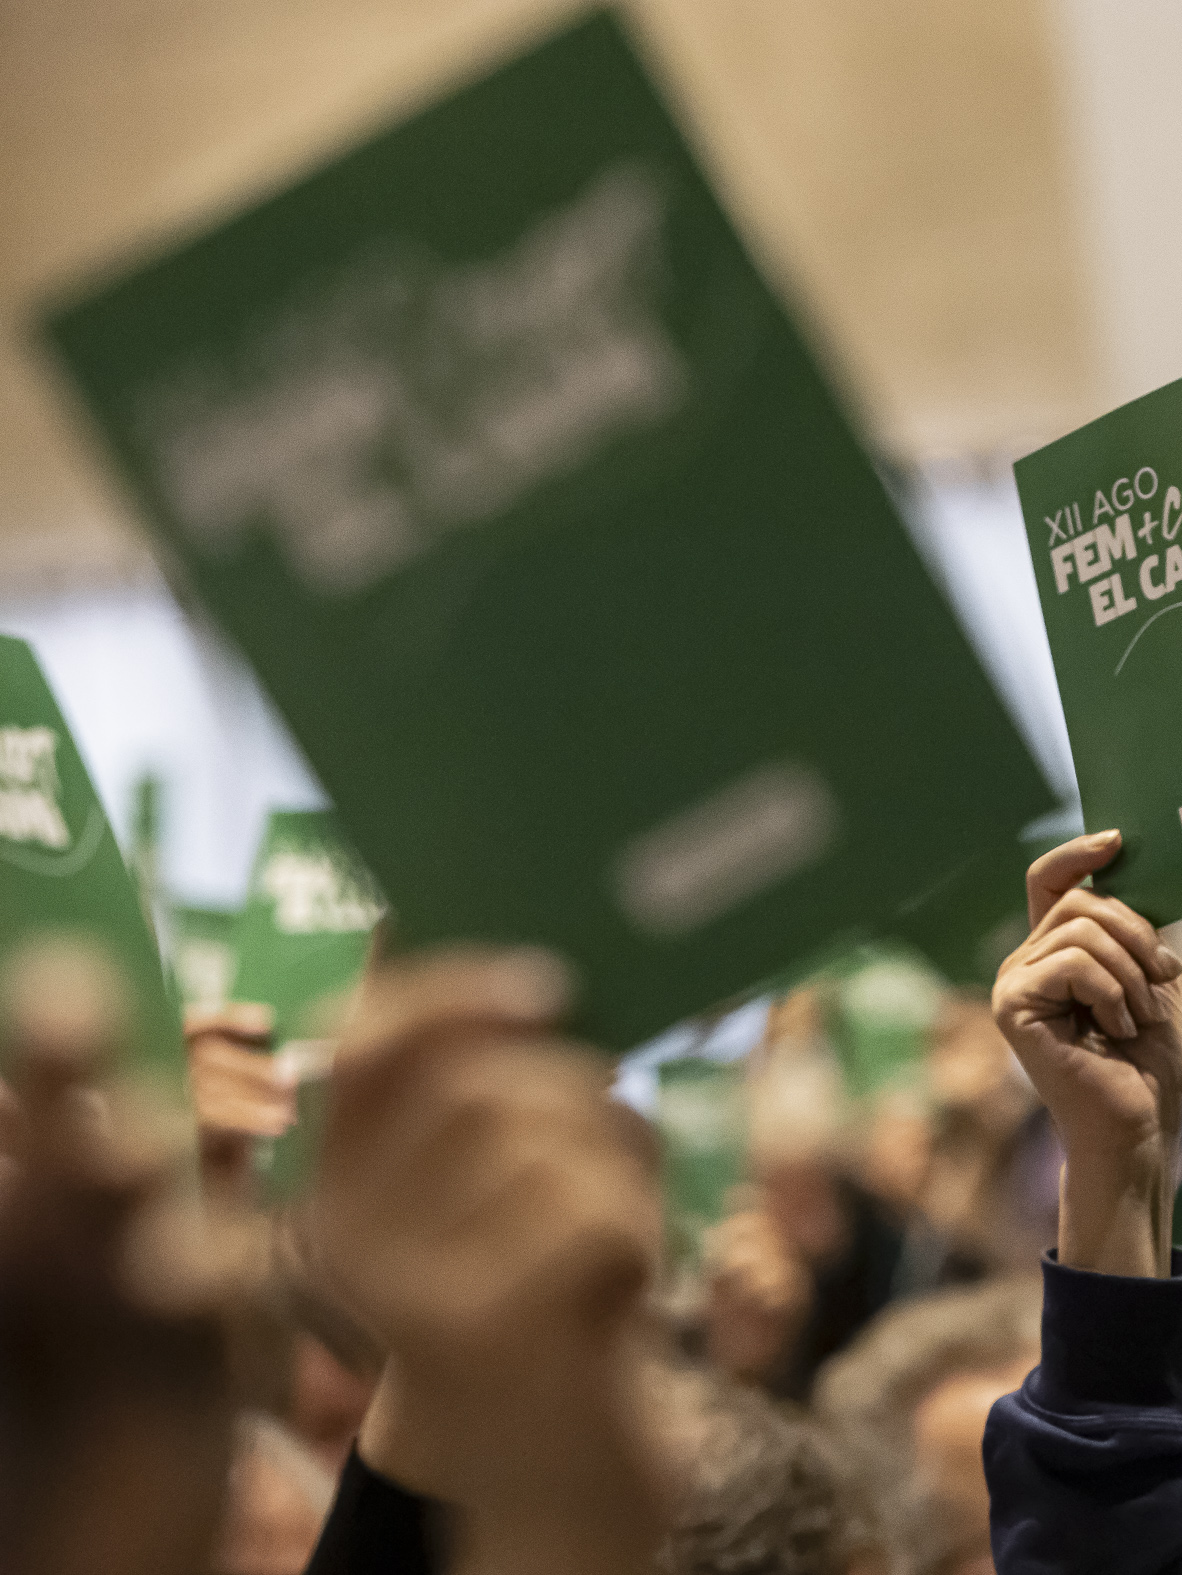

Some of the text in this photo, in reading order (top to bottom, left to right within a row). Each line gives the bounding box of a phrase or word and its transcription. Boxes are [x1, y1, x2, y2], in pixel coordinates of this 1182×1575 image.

[1044, 467, 1158, 546] XII AGO
[1050, 513, 1137, 594] FEM
[1089, 573, 1137, 627] EL
